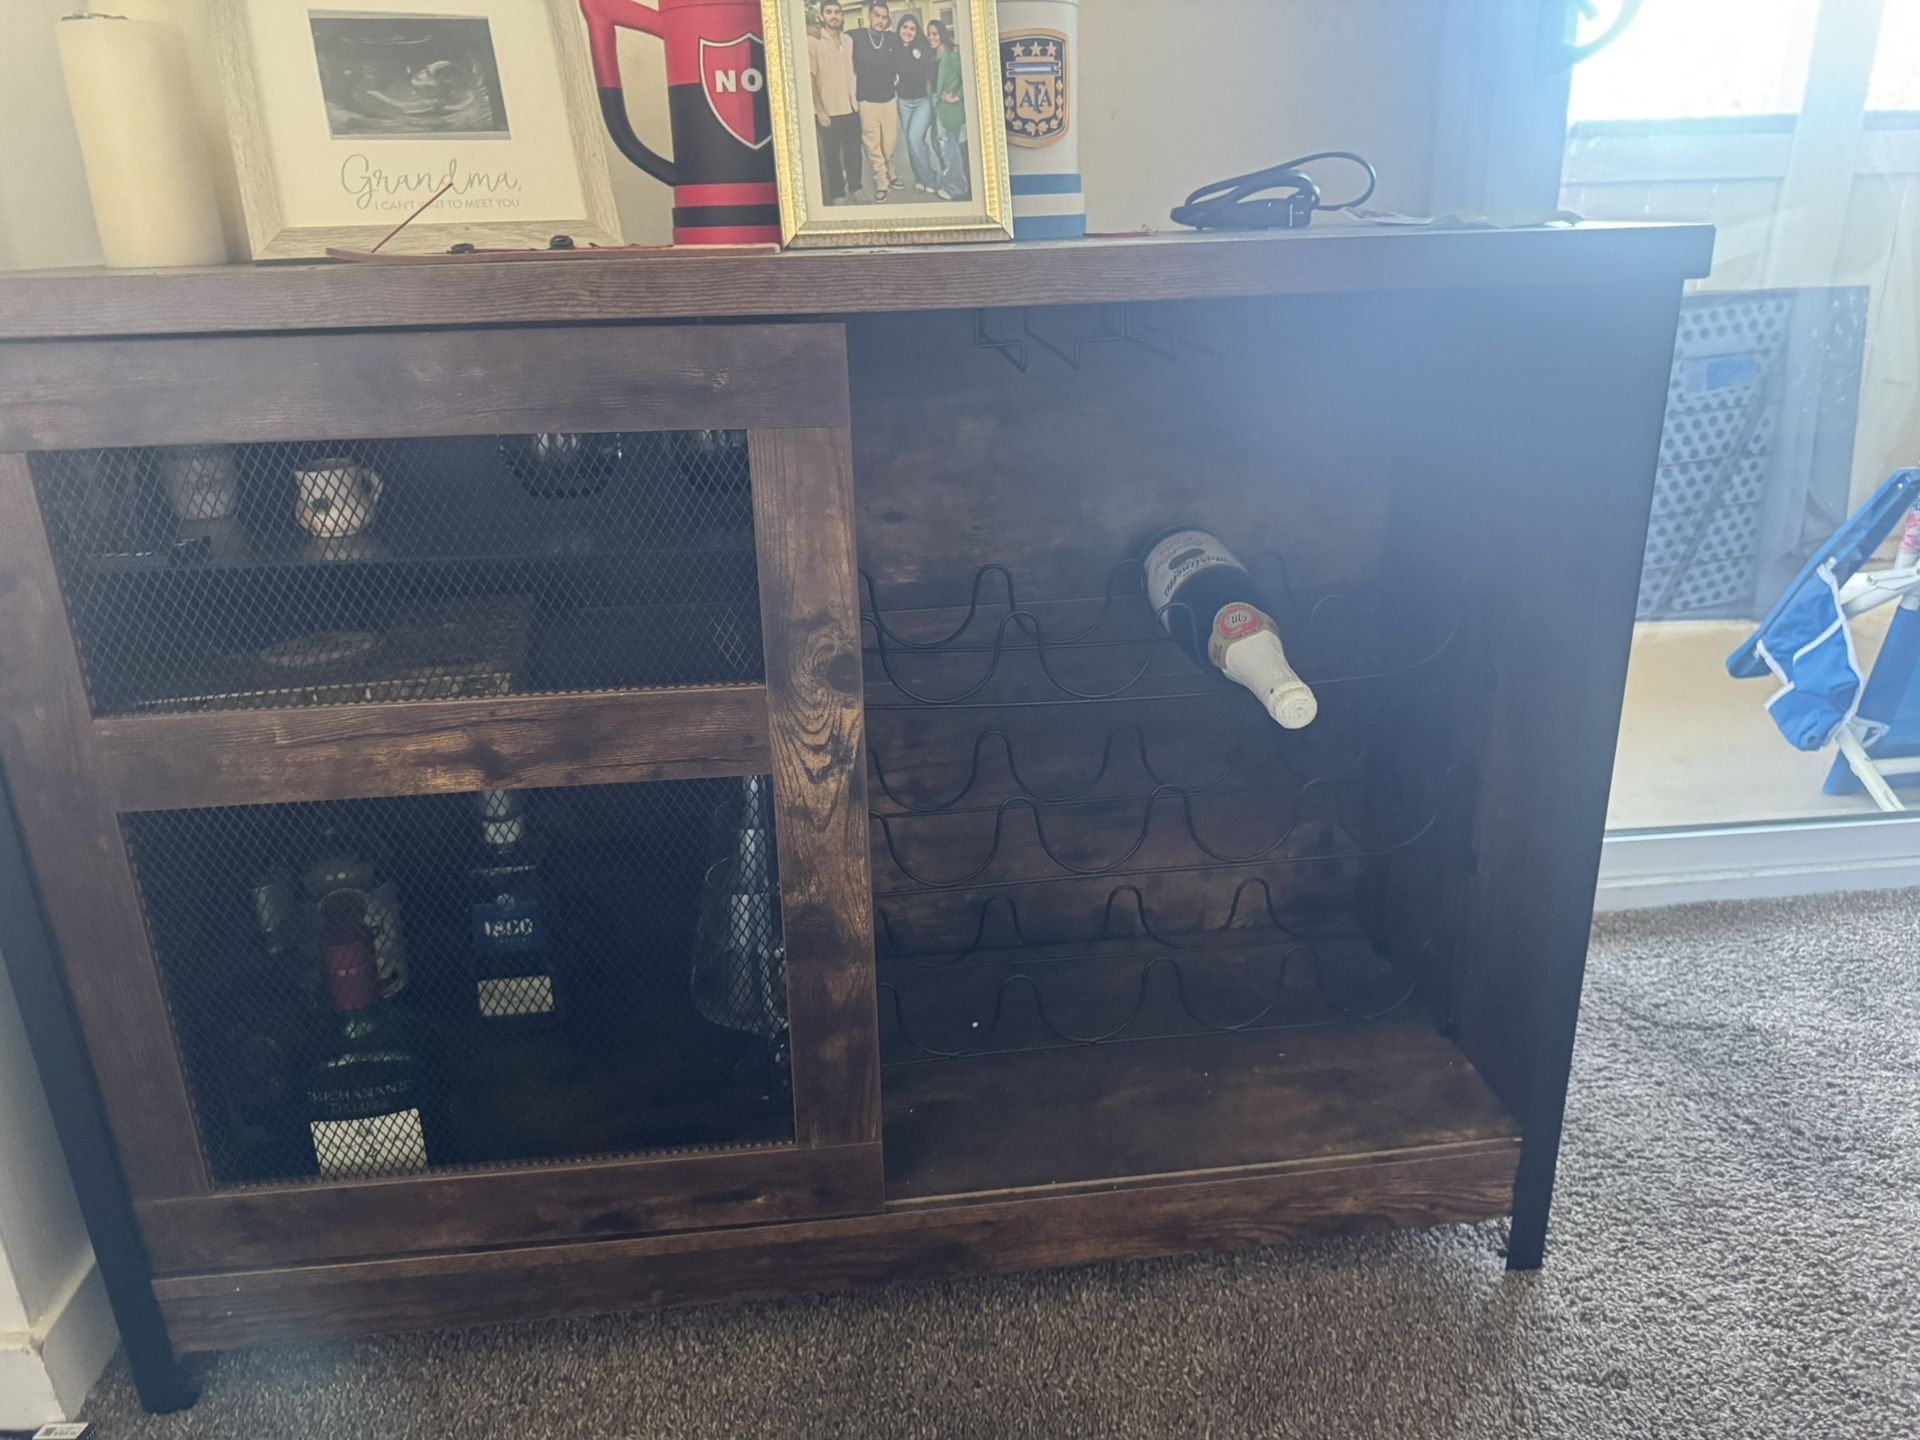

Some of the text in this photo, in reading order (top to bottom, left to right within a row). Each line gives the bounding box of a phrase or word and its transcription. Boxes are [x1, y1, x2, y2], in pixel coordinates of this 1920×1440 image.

[1019, 79, 1053, 114] AFA
[341, 153, 523, 210] Grandma,
[381, 200, 415, 210] CAN'T
[447, 199, 462, 209] TO
[465, 198, 494, 209] MEET
[496, 197, 520, 208] YOU
